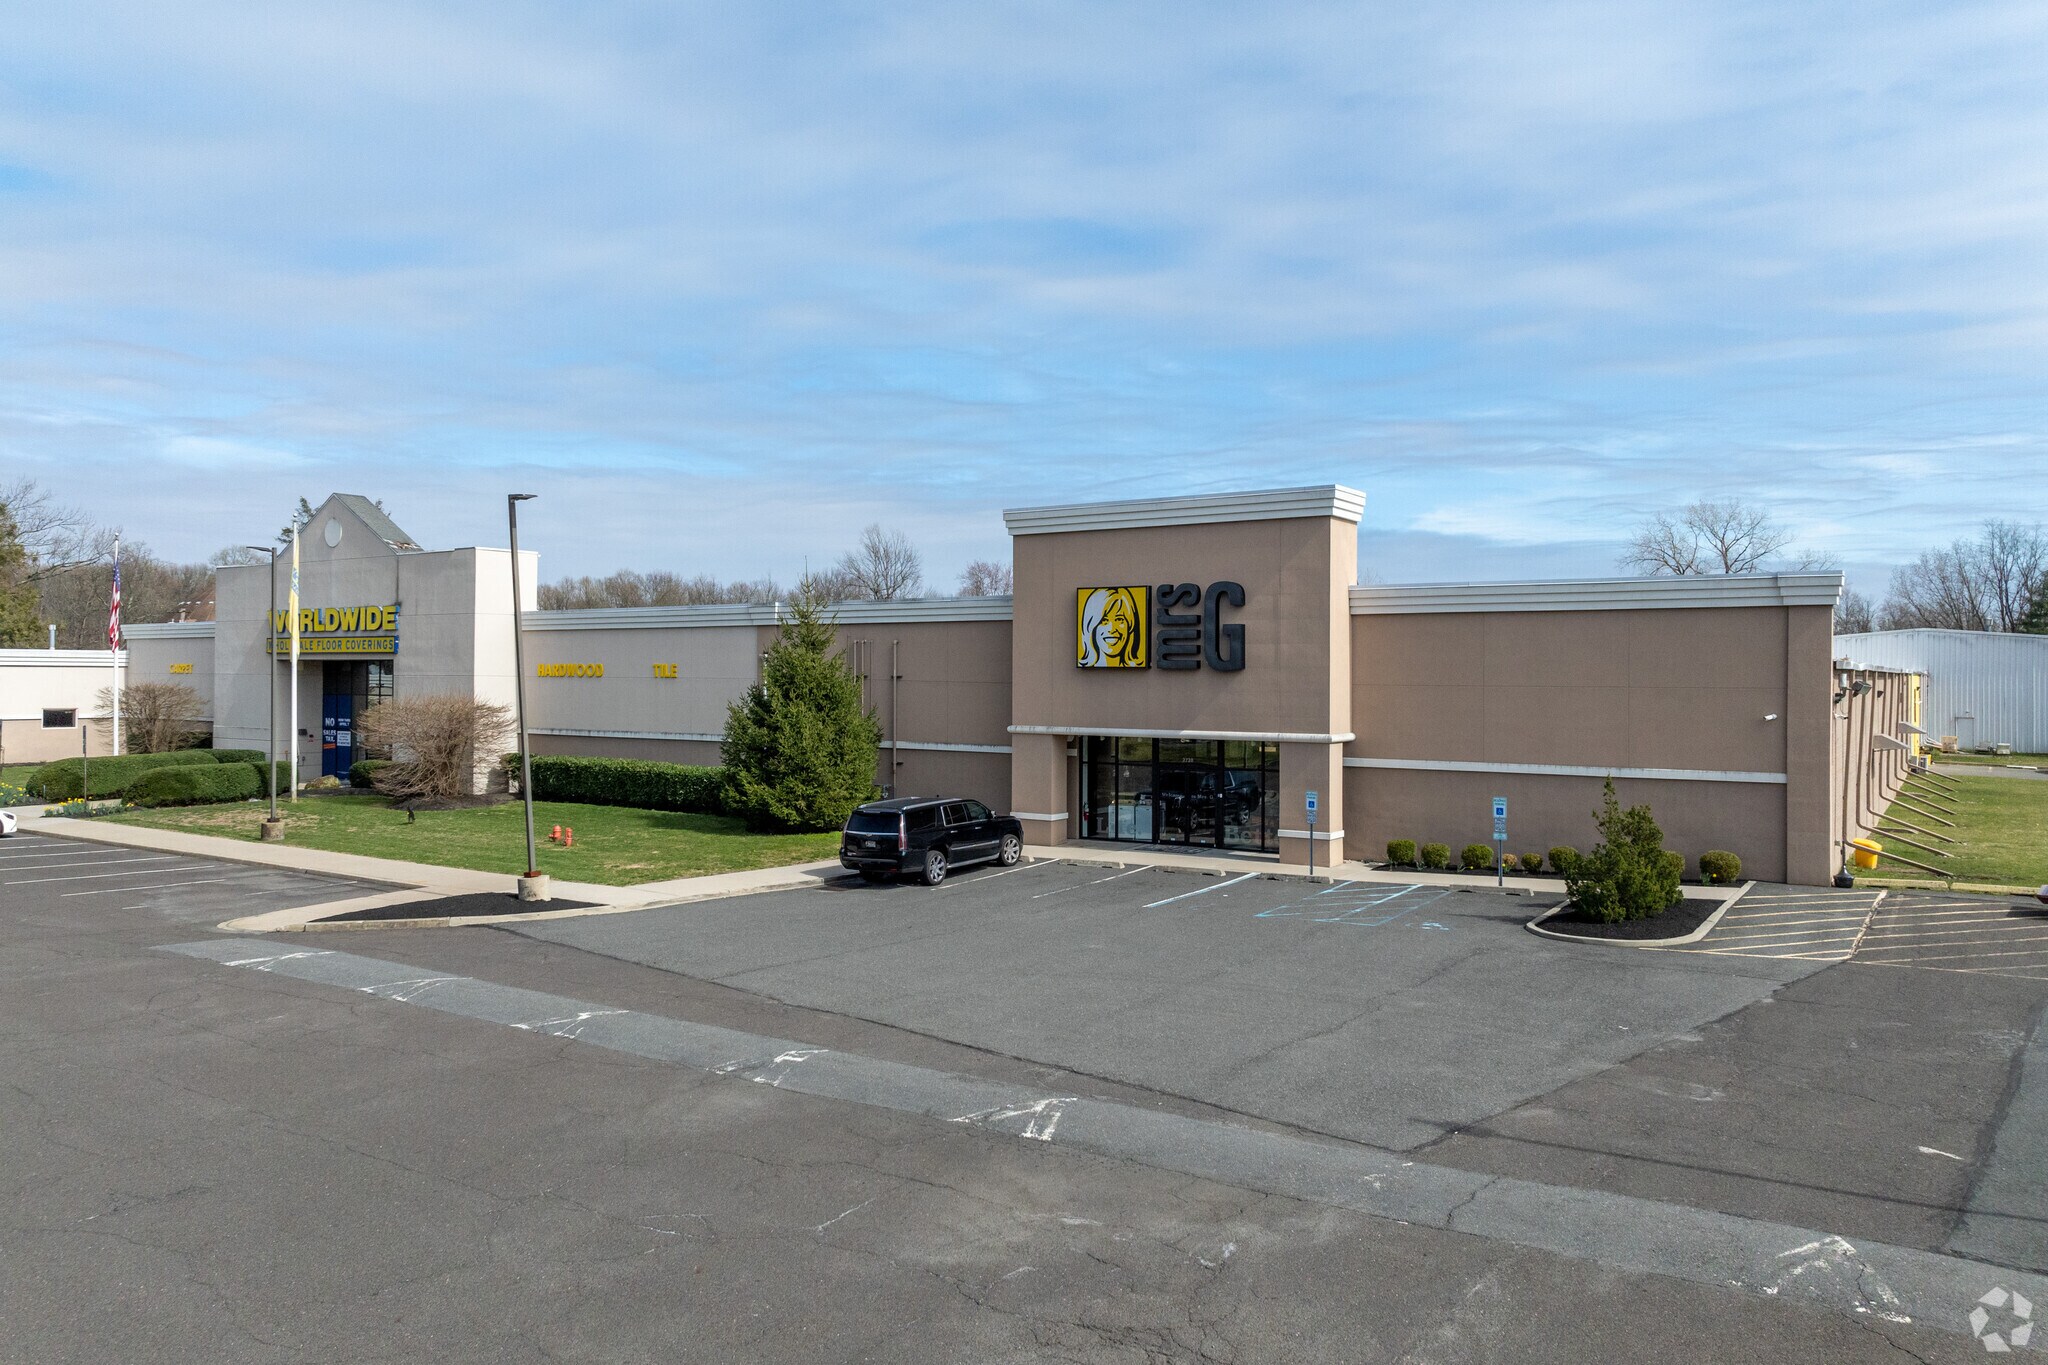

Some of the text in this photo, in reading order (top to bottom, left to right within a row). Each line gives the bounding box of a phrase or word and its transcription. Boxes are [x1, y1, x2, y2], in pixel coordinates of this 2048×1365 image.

[1156, 581, 1246, 672] mrs G
[317, 639, 342, 650] FLOOR
[346, 638, 394, 650] COVERINGS
[537, 663, 604, 677] HARDWOOD
[652, 663, 678, 678] TILE
[325, 718, 335, 727] NO
